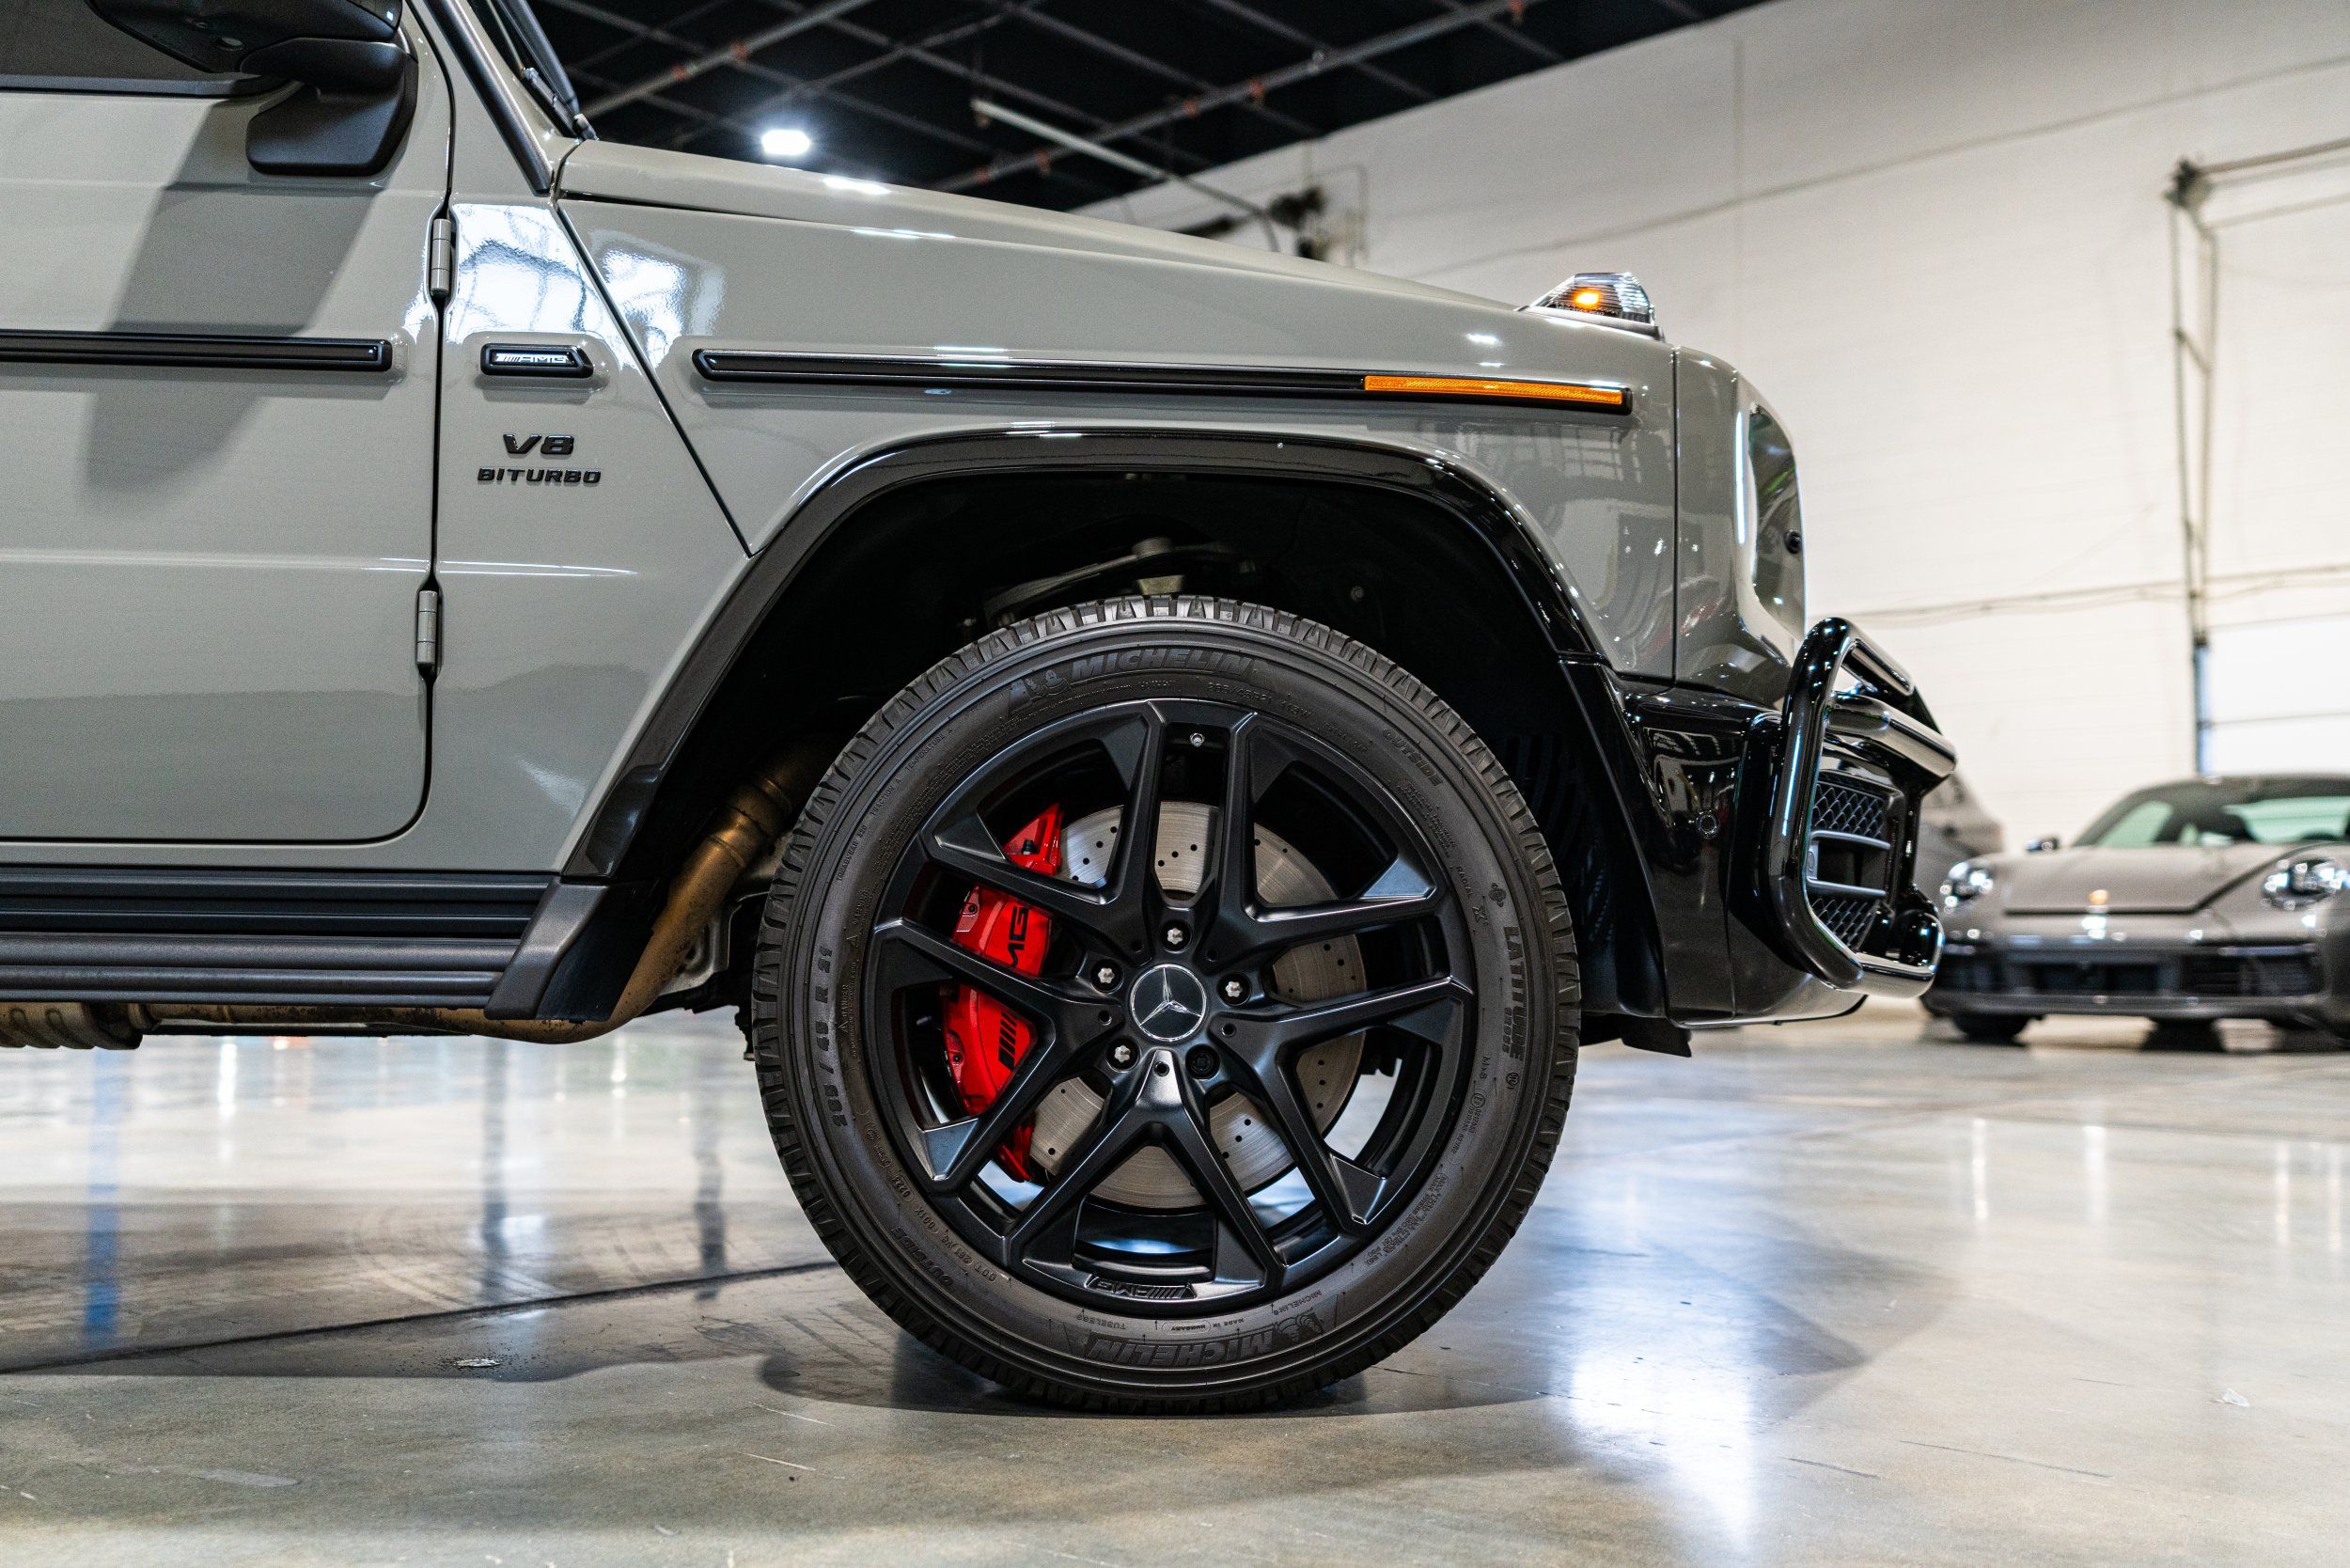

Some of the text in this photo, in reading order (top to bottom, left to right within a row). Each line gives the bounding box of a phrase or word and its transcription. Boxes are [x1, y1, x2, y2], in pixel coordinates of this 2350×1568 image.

[518, 353, 569, 364] AMG
[502, 433, 575, 455] V8
[477, 466, 602, 484] BITURBO
[1067, 649, 1252, 682] MICHELIN
[1380, 725, 1443, 788] OUTSIDE
[869, 783, 896, 817] TRACTION
[902, 730, 946, 773] TEMPERATURE
[1455, 864, 1474, 898] RADIAL
[815, 944, 833, 974] 21
[814, 984, 828, 1003] R
[1503, 922, 1527, 1060] LATITUDE
[814, 1019, 831, 1053] 45
[1500, 1006, 1512, 1055] CROSS
[822, 1081, 849, 1130] 285
[888, 1224, 956, 1290] OUTSIDE
[1277, 1288, 1324, 1314] MICHELIN
[1074, 1311, 1127, 1330] TUBELESS
[1169, 1324, 1206, 1332] HUNGARY
[1222, 1317, 1245, 1327] MADE
[1085, 1328, 1279, 1367] MICHELIN
